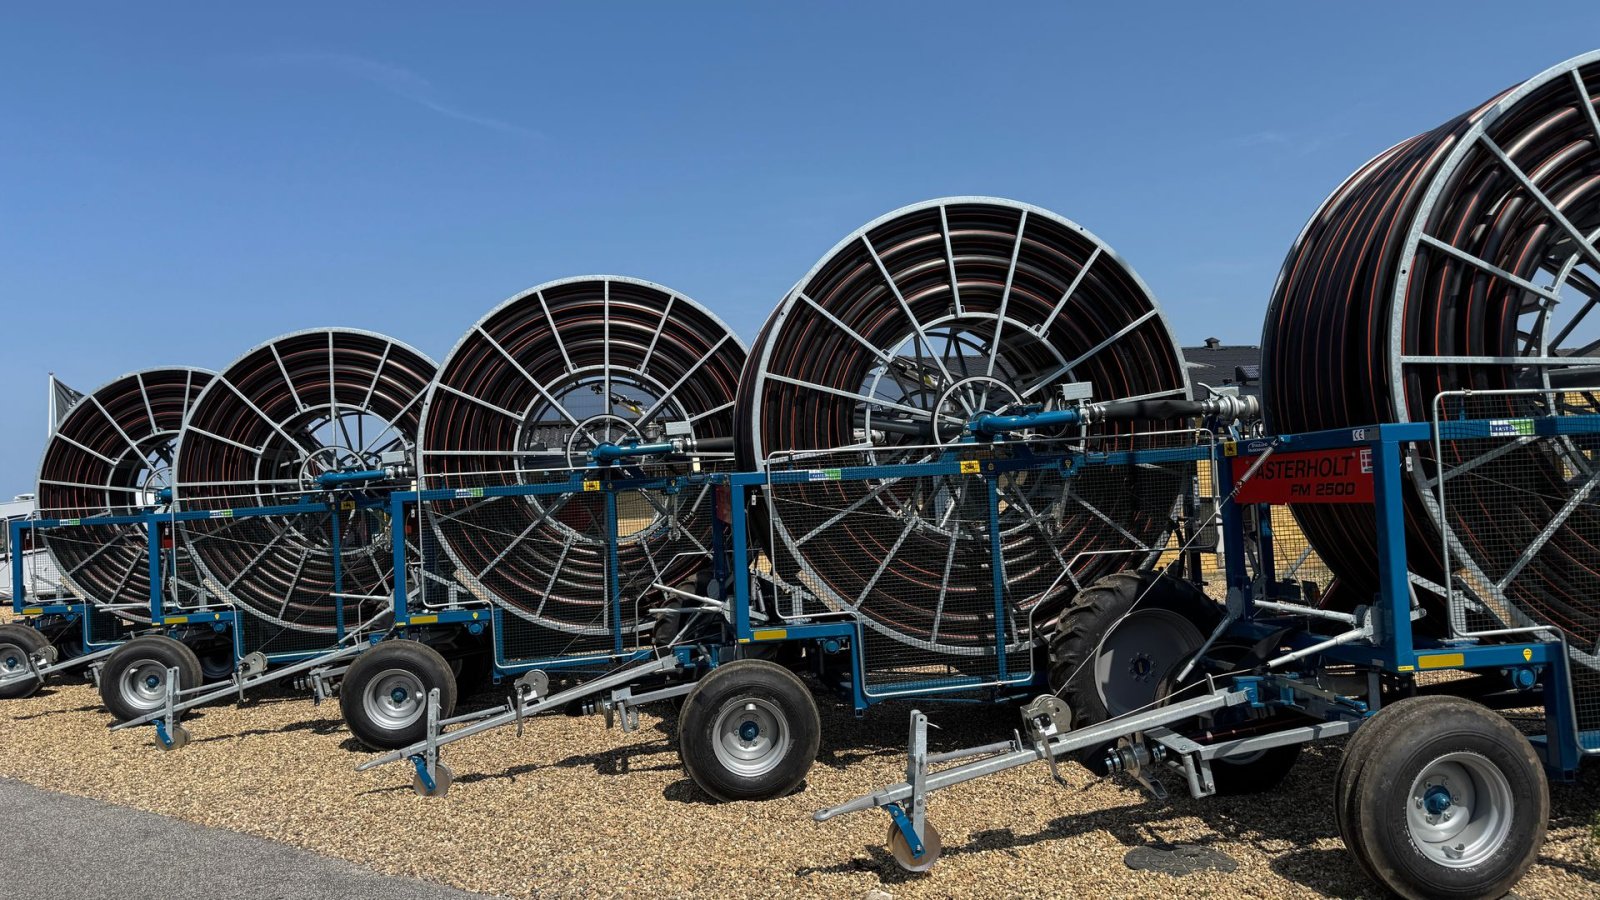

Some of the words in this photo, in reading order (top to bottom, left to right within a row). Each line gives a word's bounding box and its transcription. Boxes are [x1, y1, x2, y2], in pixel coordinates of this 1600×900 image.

[1249, 457, 1354, 480] ASTERHOLT
[1291, 484, 1310, 496] FM
[1316, 482, 1356, 496] 2500
